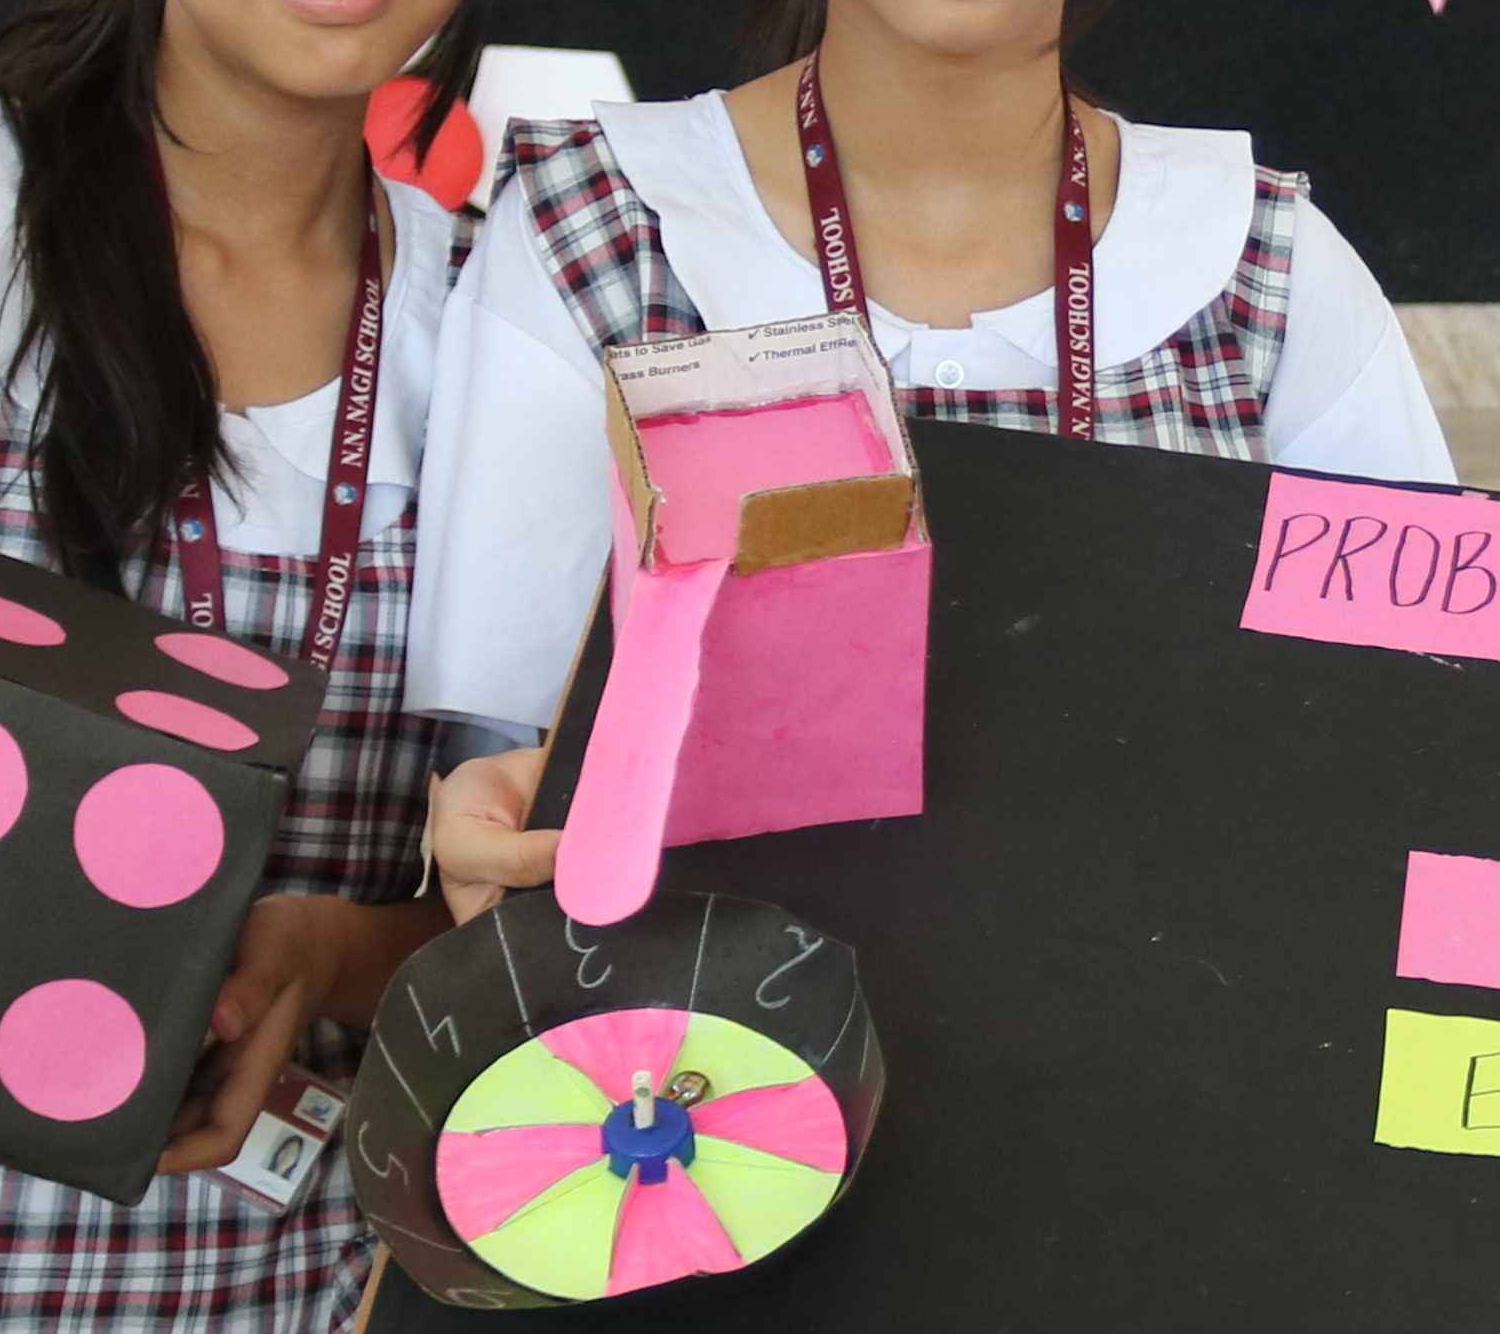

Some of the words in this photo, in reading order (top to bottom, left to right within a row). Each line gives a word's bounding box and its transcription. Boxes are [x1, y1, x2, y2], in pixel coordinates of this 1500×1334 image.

[820, 207, 855, 303] SCHOOL
[356, 278, 380, 364] SCHOOL
[763, 322, 824, 338] Stainless
[1067, 263, 1091, 353] SCHOOL
[648, 361, 700, 377] Burners
[652, 342, 684, 354] Save
[762, 344, 816, 360] Thermal
[346, 367, 373, 423] NAGI
[1071, 355, 1092, 411] NAGI
[314, 553, 351, 649] SCHOOL
